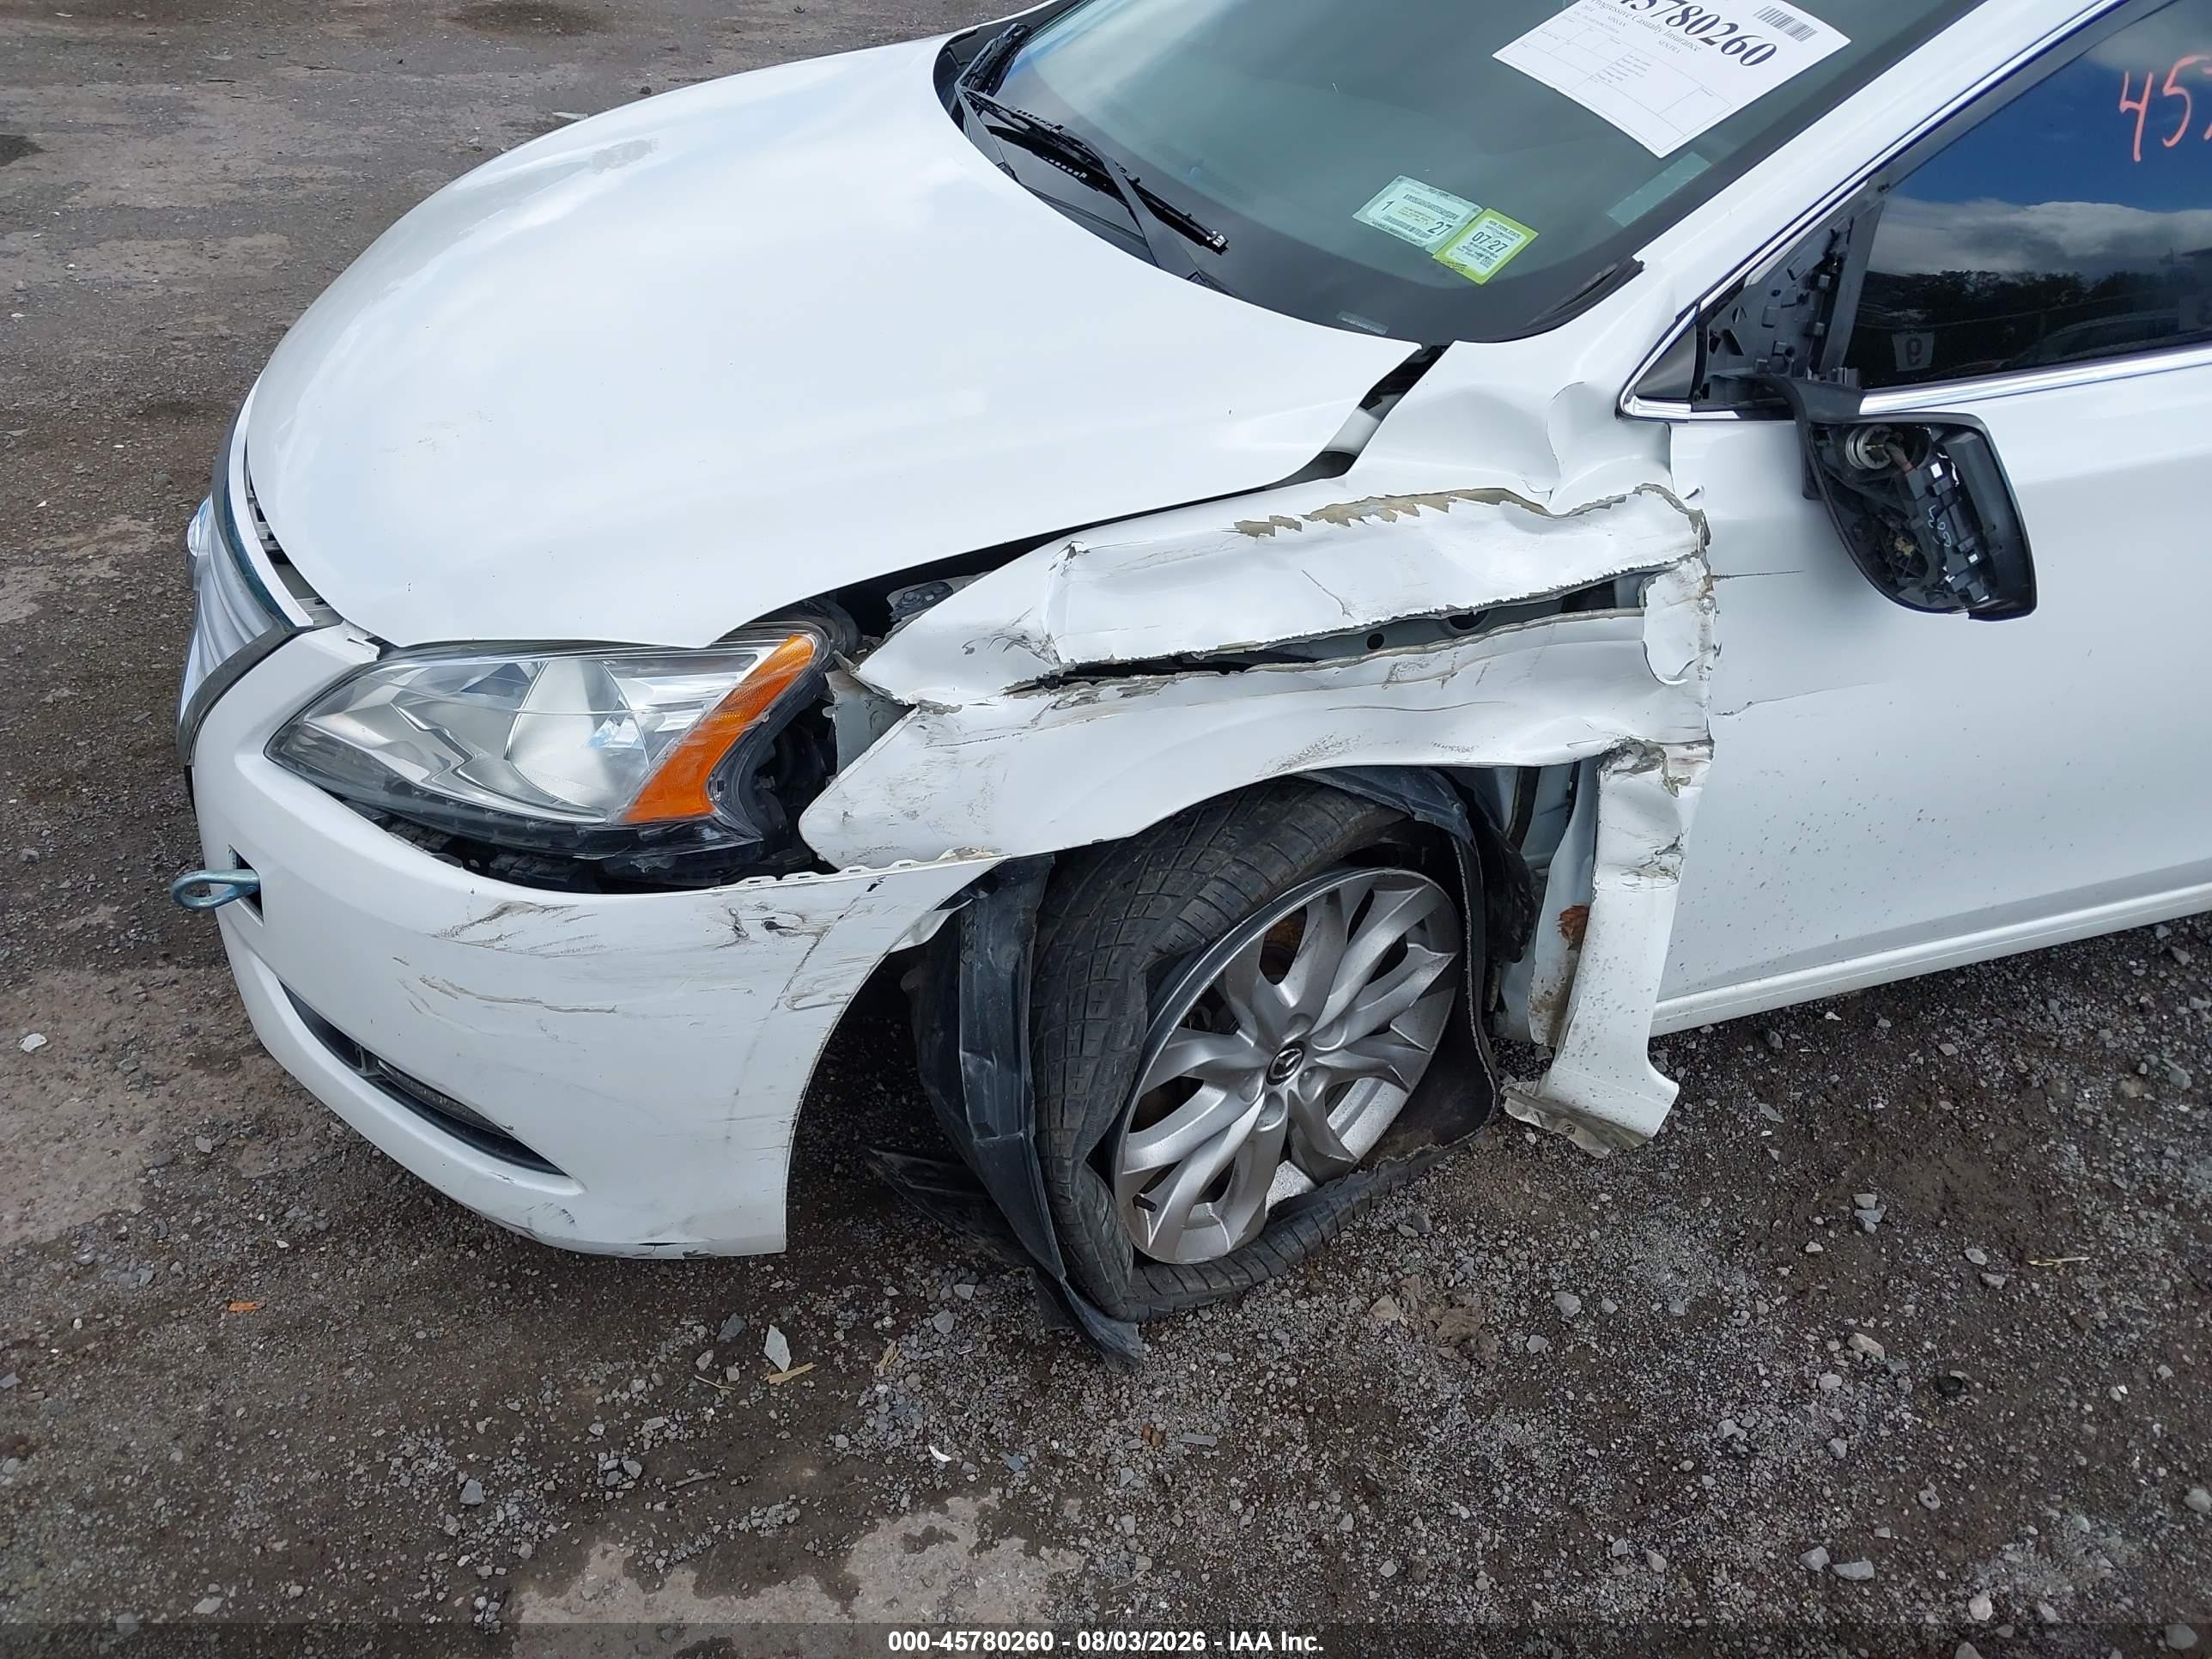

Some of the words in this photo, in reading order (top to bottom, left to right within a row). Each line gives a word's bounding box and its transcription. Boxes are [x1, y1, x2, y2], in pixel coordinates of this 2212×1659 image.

[1631, 14, 1663, 35] Casualty
[1662, 28, 1702, 52] Insurance
[2119, 55, 2212, 162] 45
[1382, 200, 1395, 211] 1
[1428, 221, 1453, 236] 27
